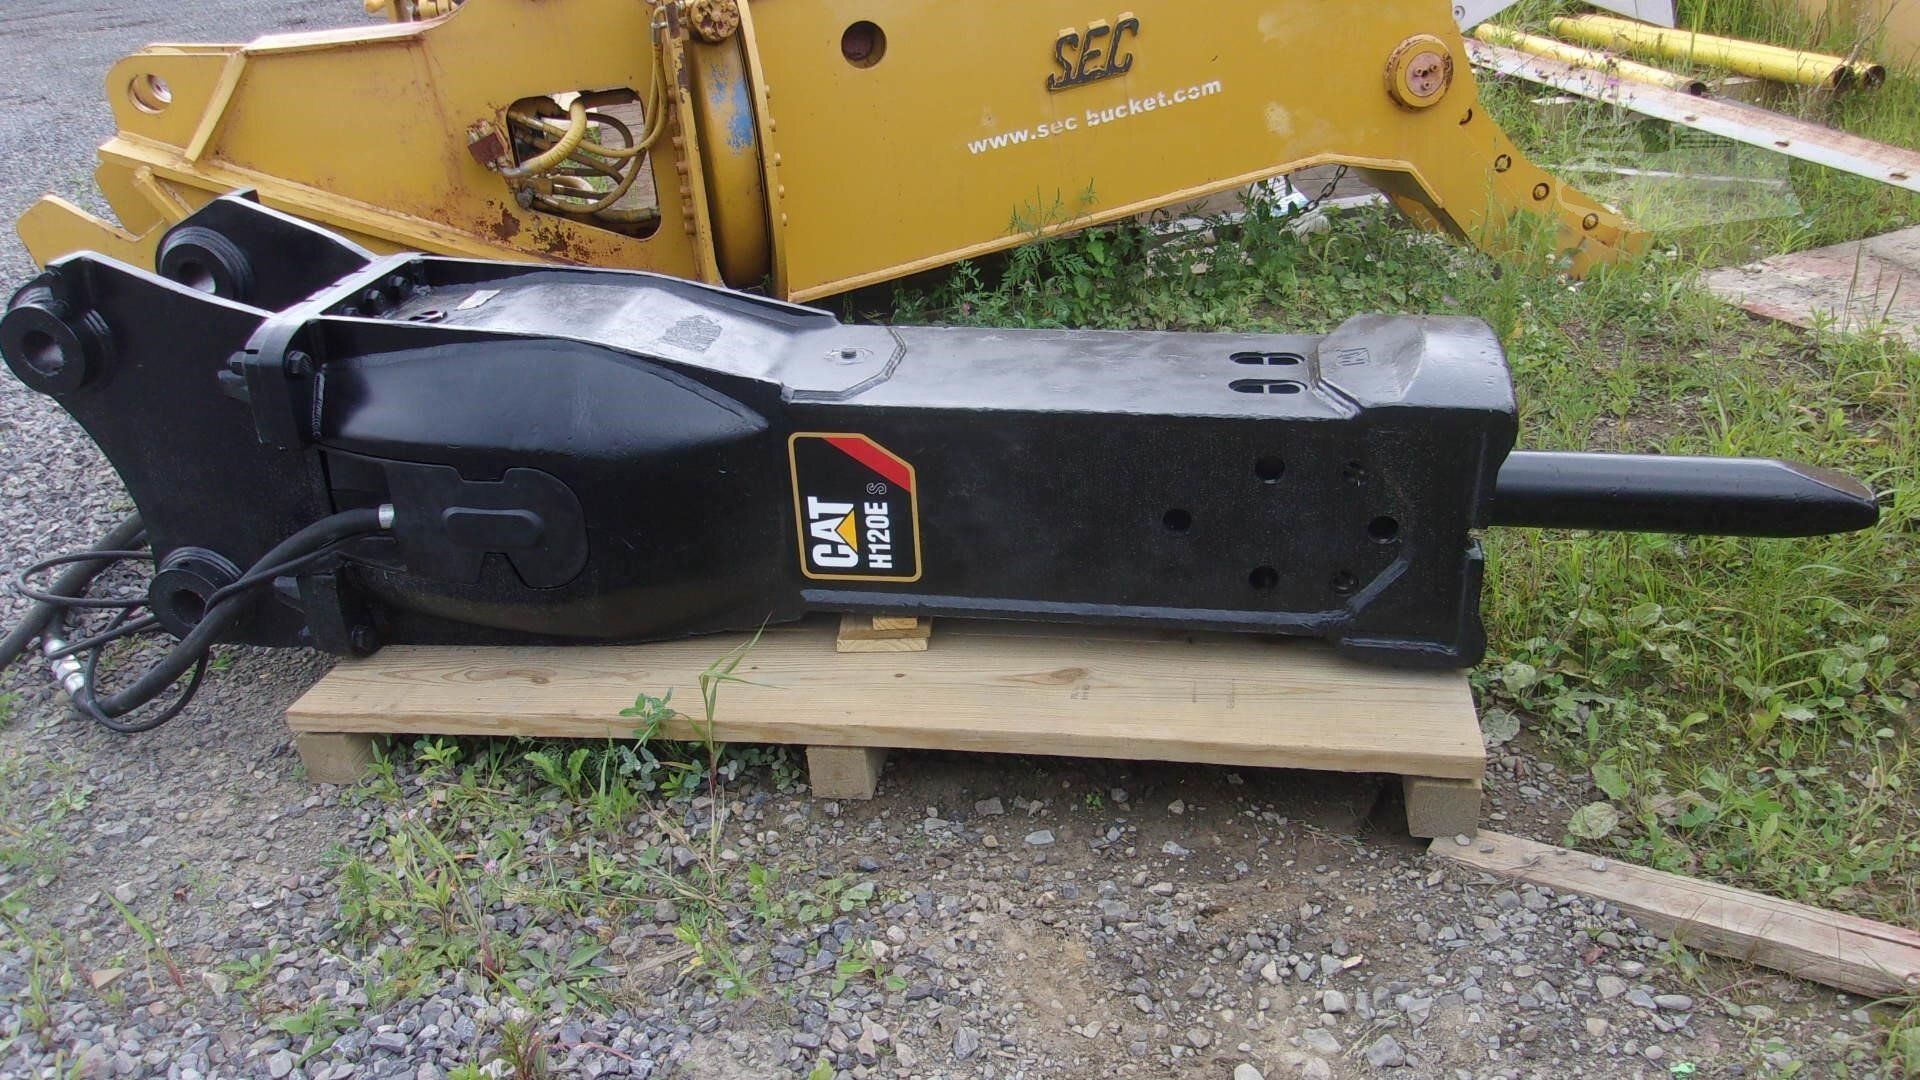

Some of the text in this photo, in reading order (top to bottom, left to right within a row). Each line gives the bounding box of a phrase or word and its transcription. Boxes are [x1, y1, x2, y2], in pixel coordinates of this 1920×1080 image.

[1046, 13, 1140, 92] SEC
[807, 496, 859, 568] CAT
[864, 482, 893, 569] H120E S
